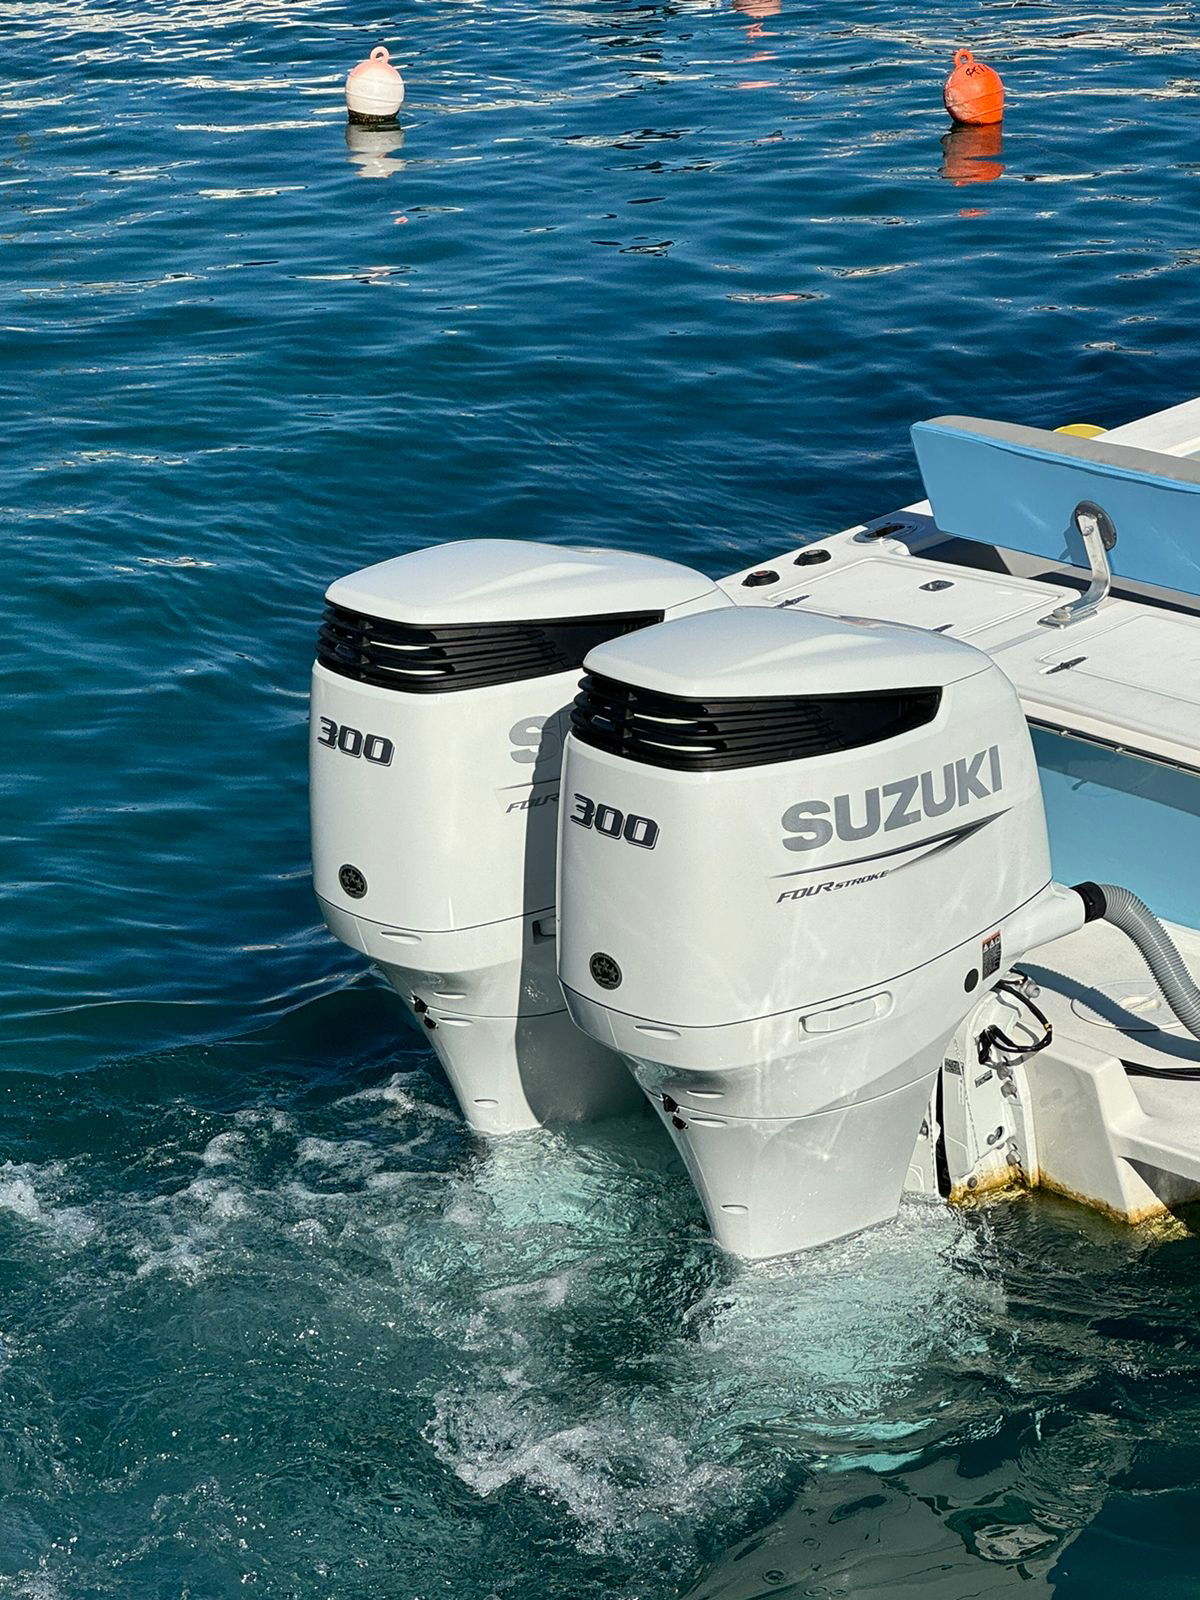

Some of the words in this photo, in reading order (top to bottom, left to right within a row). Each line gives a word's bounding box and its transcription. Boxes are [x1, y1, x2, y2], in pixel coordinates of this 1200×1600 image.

[317, 716, 395, 767] 300
[570, 793, 660, 850] 300
[781, 744, 1002, 852] SUZUKI
